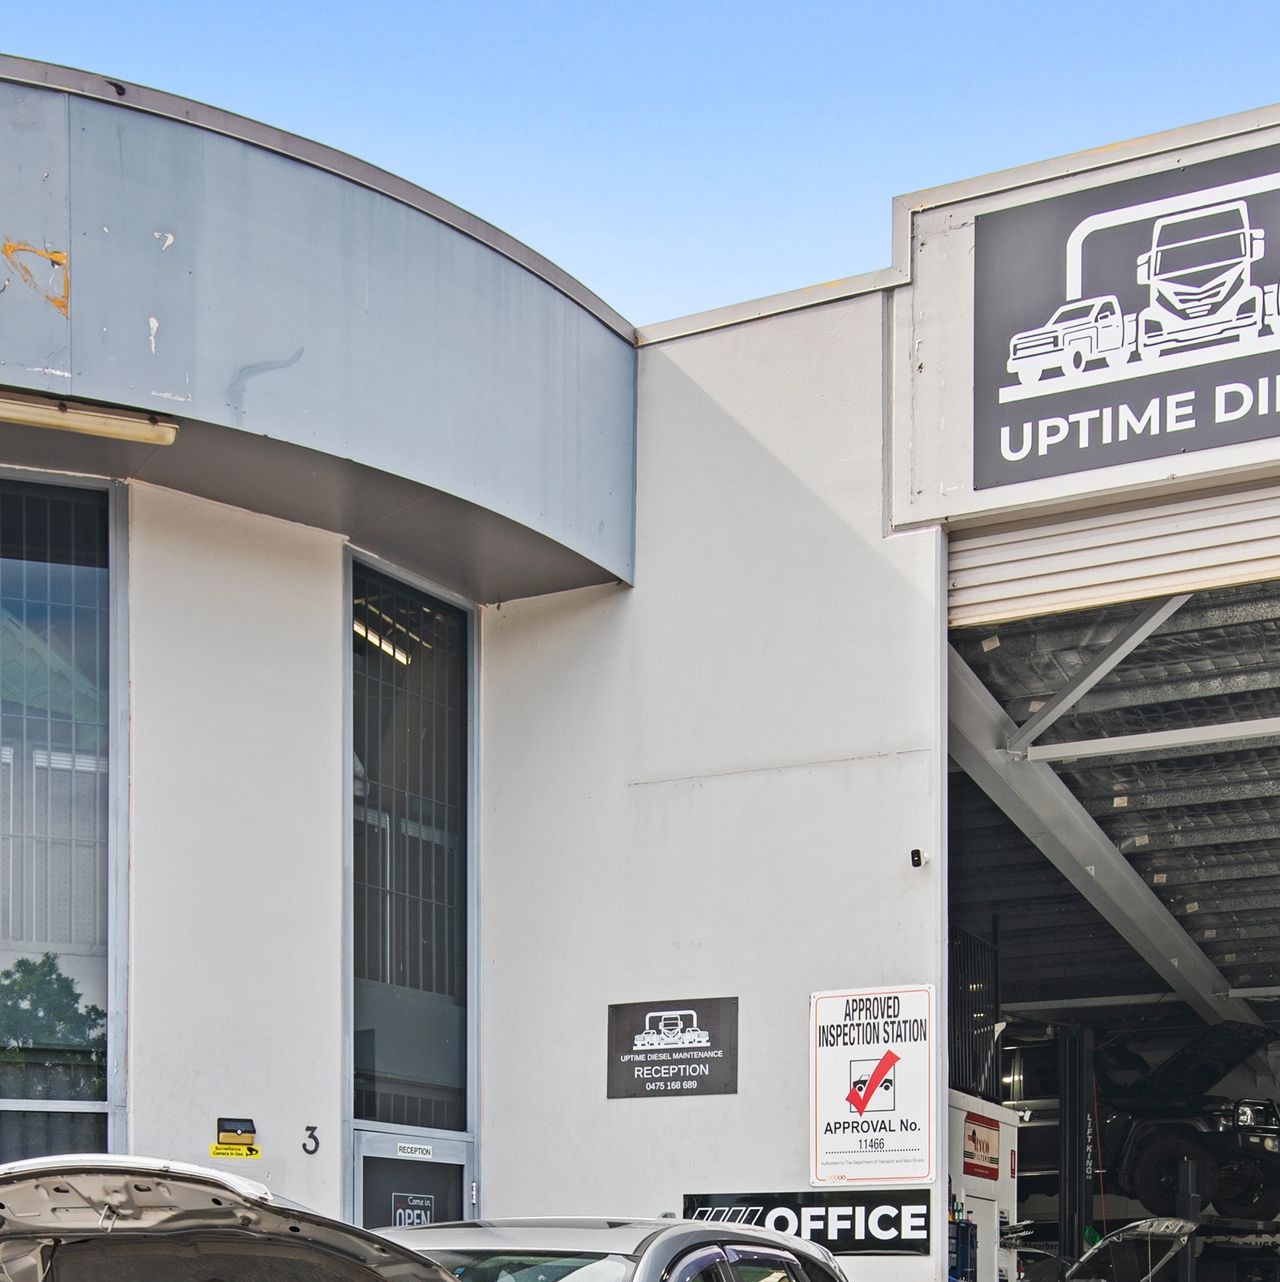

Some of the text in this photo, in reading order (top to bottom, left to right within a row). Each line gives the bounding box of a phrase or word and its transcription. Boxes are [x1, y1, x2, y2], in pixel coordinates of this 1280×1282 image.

[1001, 391, 1195, 460] UPTIME
[844, 996, 900, 1021] APPROVED
[819, 1019, 926, 1047] INSPECTION STATION
[621, 1054, 646, 1062] UPTIME
[673, 1050, 722, 1059] MAINTENANCE
[635, 1064, 708, 1078] RECEPTION
[646, 1082, 664, 1090] 0475
[667, 1081, 680, 1089] 168
[824, 1119, 920, 1134] APPROVAL No.
[302, 1126, 320, 1155] 3
[859, 1138, 884, 1149] 11466
[399, 1145, 431, 1156] RECEPTION
[396, 1209, 430, 1227] OPEN
[764, 1205, 928, 1241] OFFICE
